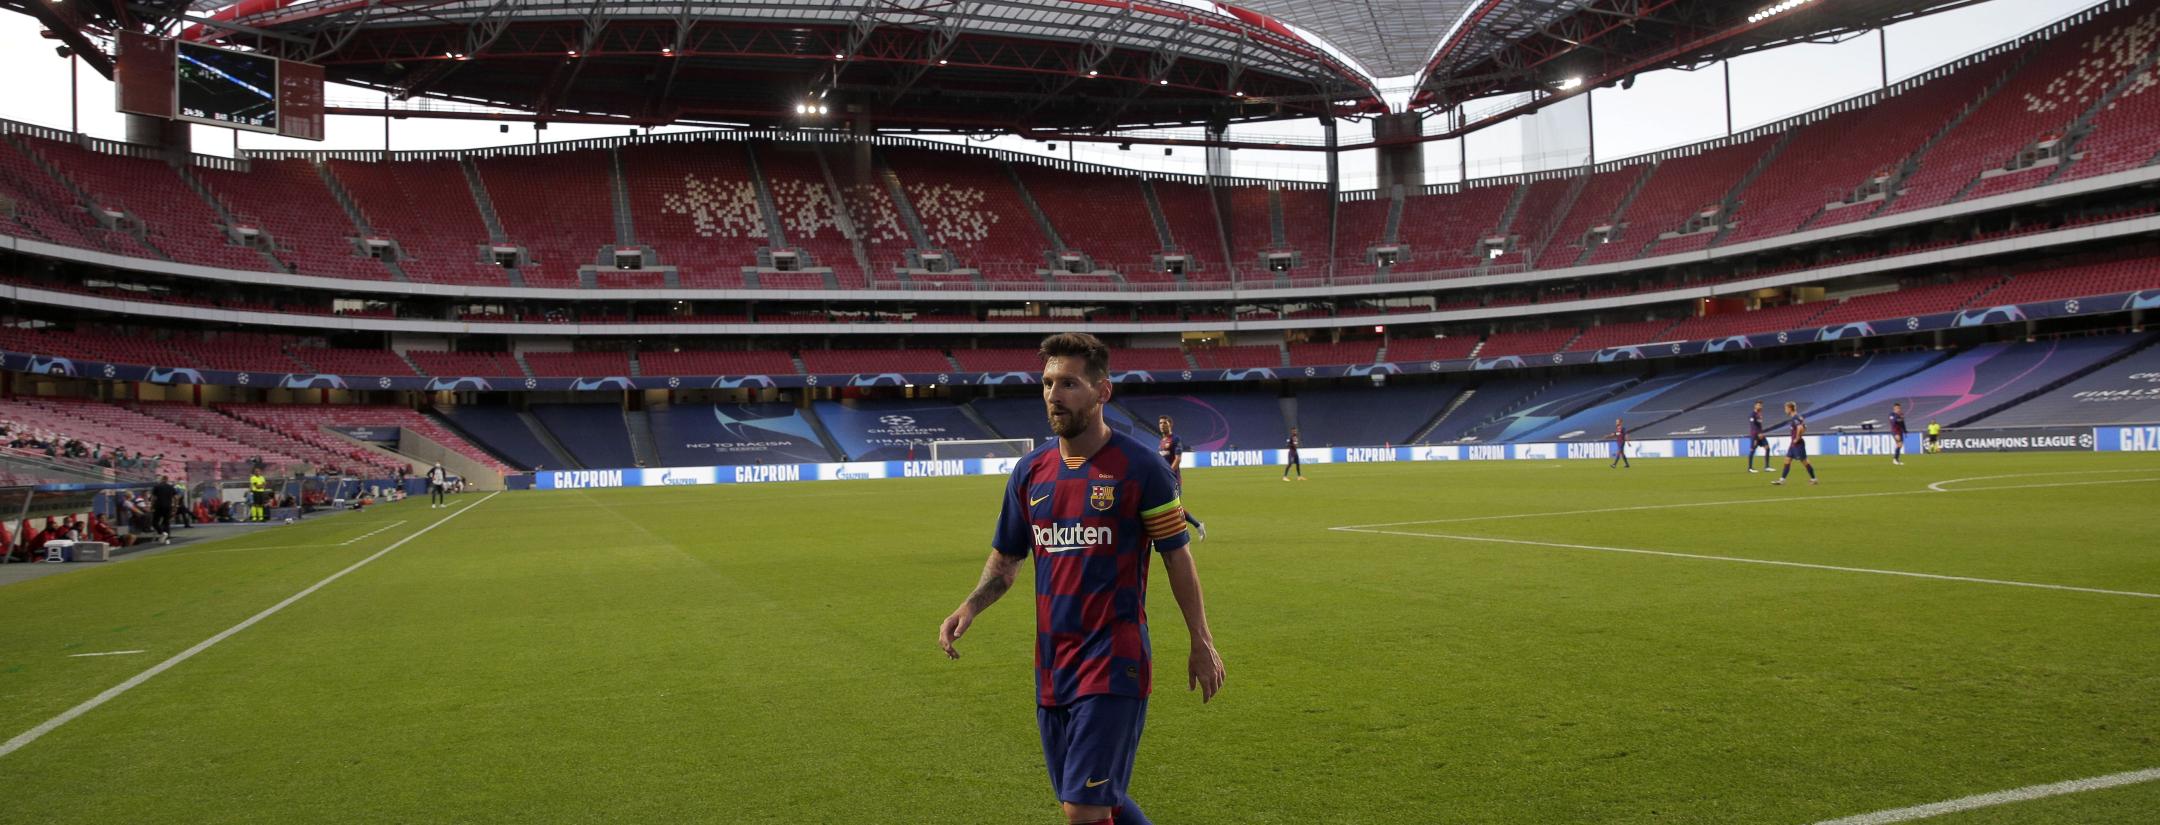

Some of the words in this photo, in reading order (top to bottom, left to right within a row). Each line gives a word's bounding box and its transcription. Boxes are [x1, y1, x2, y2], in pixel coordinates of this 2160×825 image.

[736, 440, 792, 448] RACISM
[1567, 442, 1610, 459] GAZPROM
[1687, 439, 1739, 457] GAZPROM
[1939, 438, 1963, 449] UEFA
[1965, 436, 2029, 449] CHAMPIONS
[2031, 435, 2076, 447] LEAGUE
[1210, 451, 1263, 466] GAZPROM
[1346, 447, 1397, 463] GAZPROM
[1468, 445, 1505, 460] GAZPROM
[735, 465, 800, 482] GAZPROM
[903, 460, 964, 477] GAZPROM
[554, 470, 623, 488] GAZPROM
[1032, 523, 1112, 545] Rakuten
